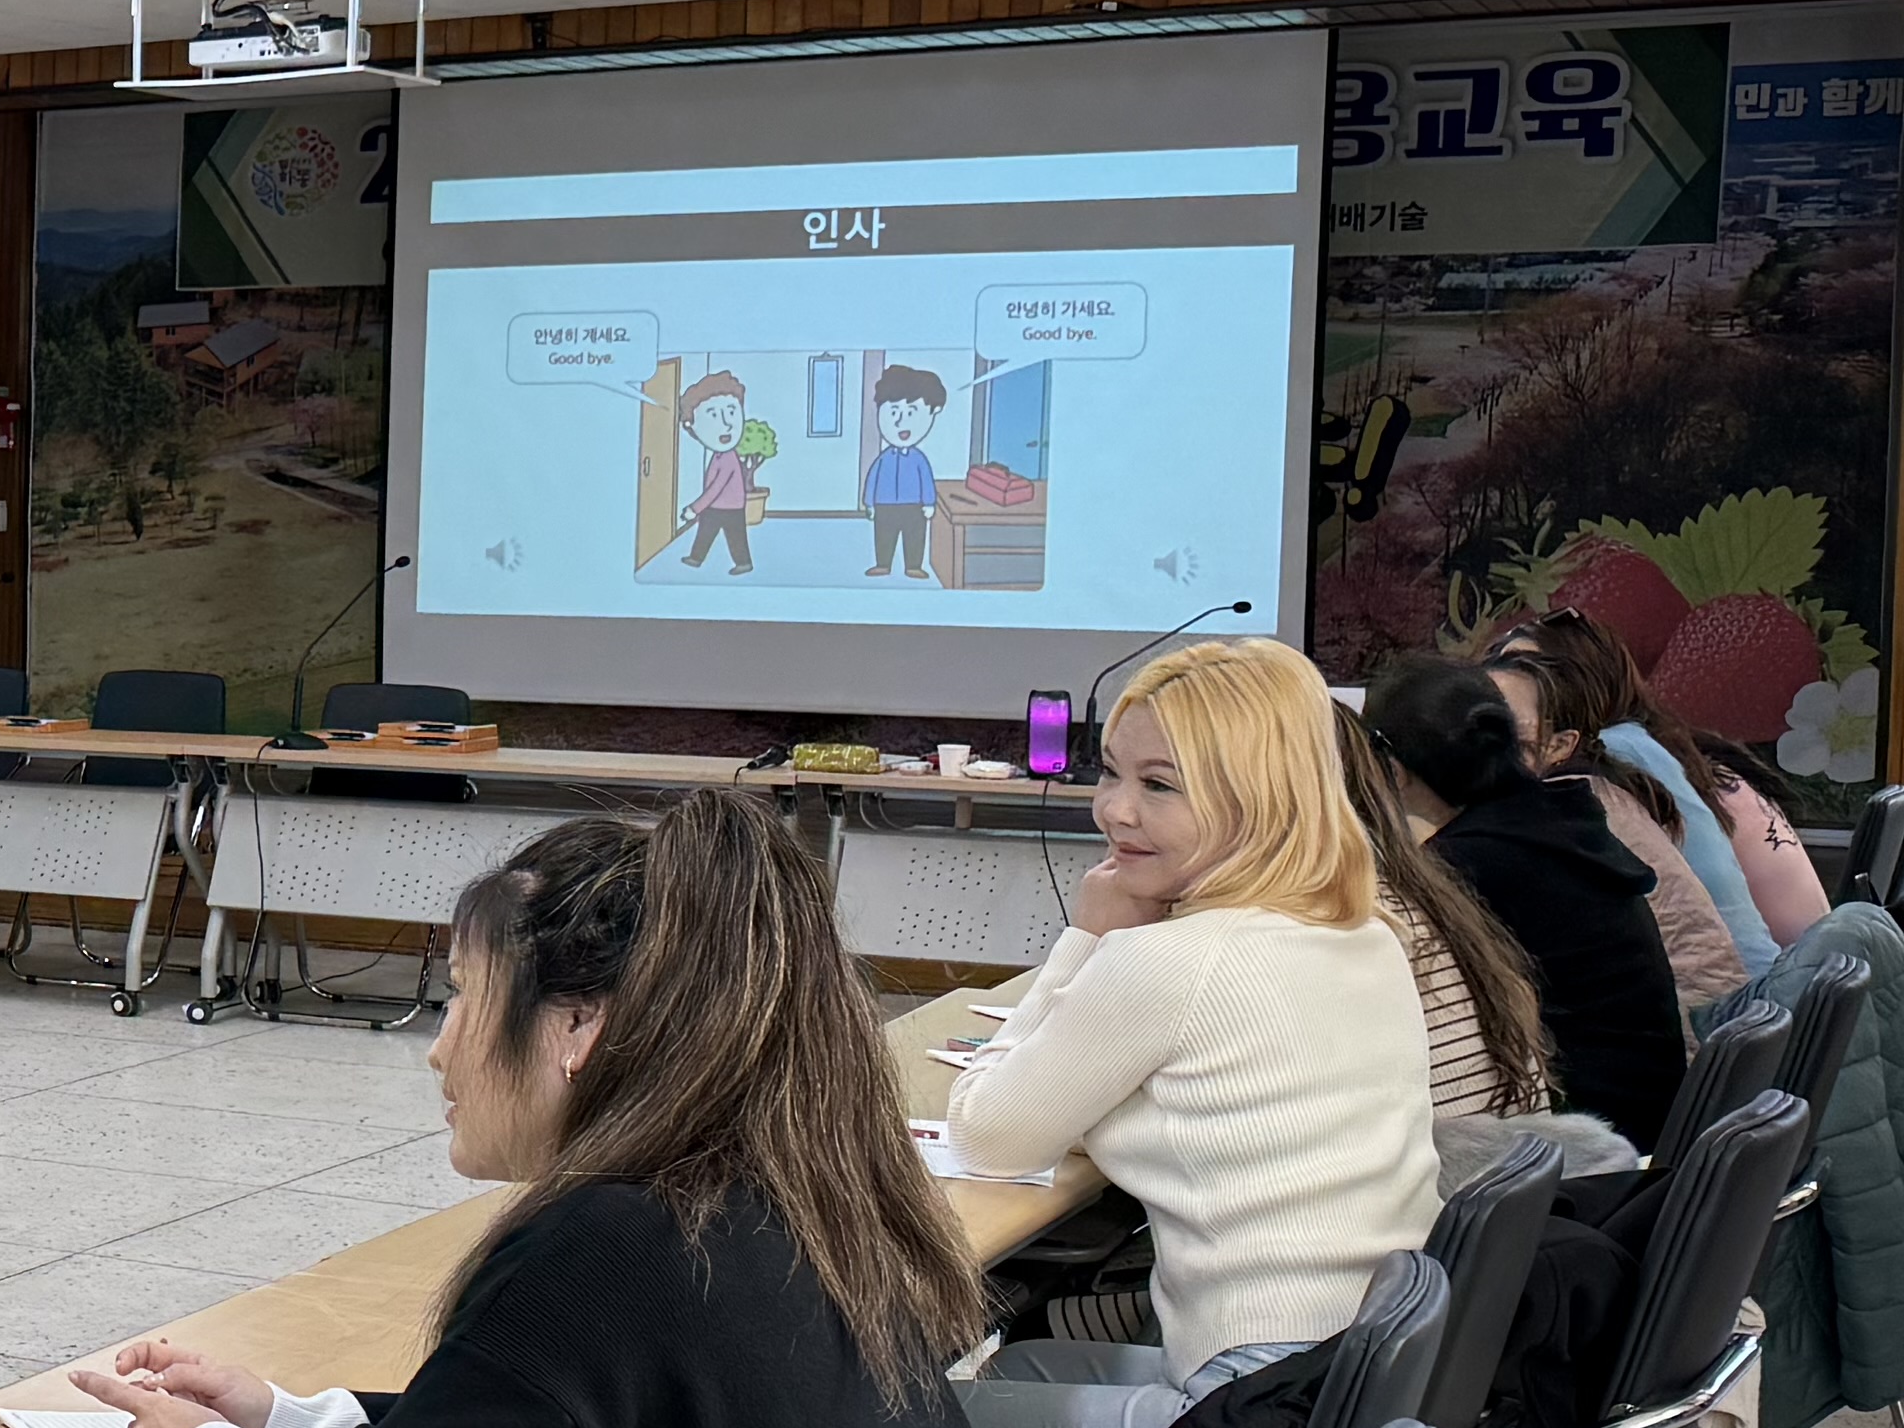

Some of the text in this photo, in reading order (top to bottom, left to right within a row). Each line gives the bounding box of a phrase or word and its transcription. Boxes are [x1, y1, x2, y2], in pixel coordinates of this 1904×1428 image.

[1329, 201, 1428, 233] 배기술
[803, 208, 886, 250] 인사
[1006, 300, 1116, 319] 안녕히 가세요.
[533, 327, 578, 345] 안녕히
[1022, 325, 1098, 342] Good bye.
[548, 352, 583, 365] Good
